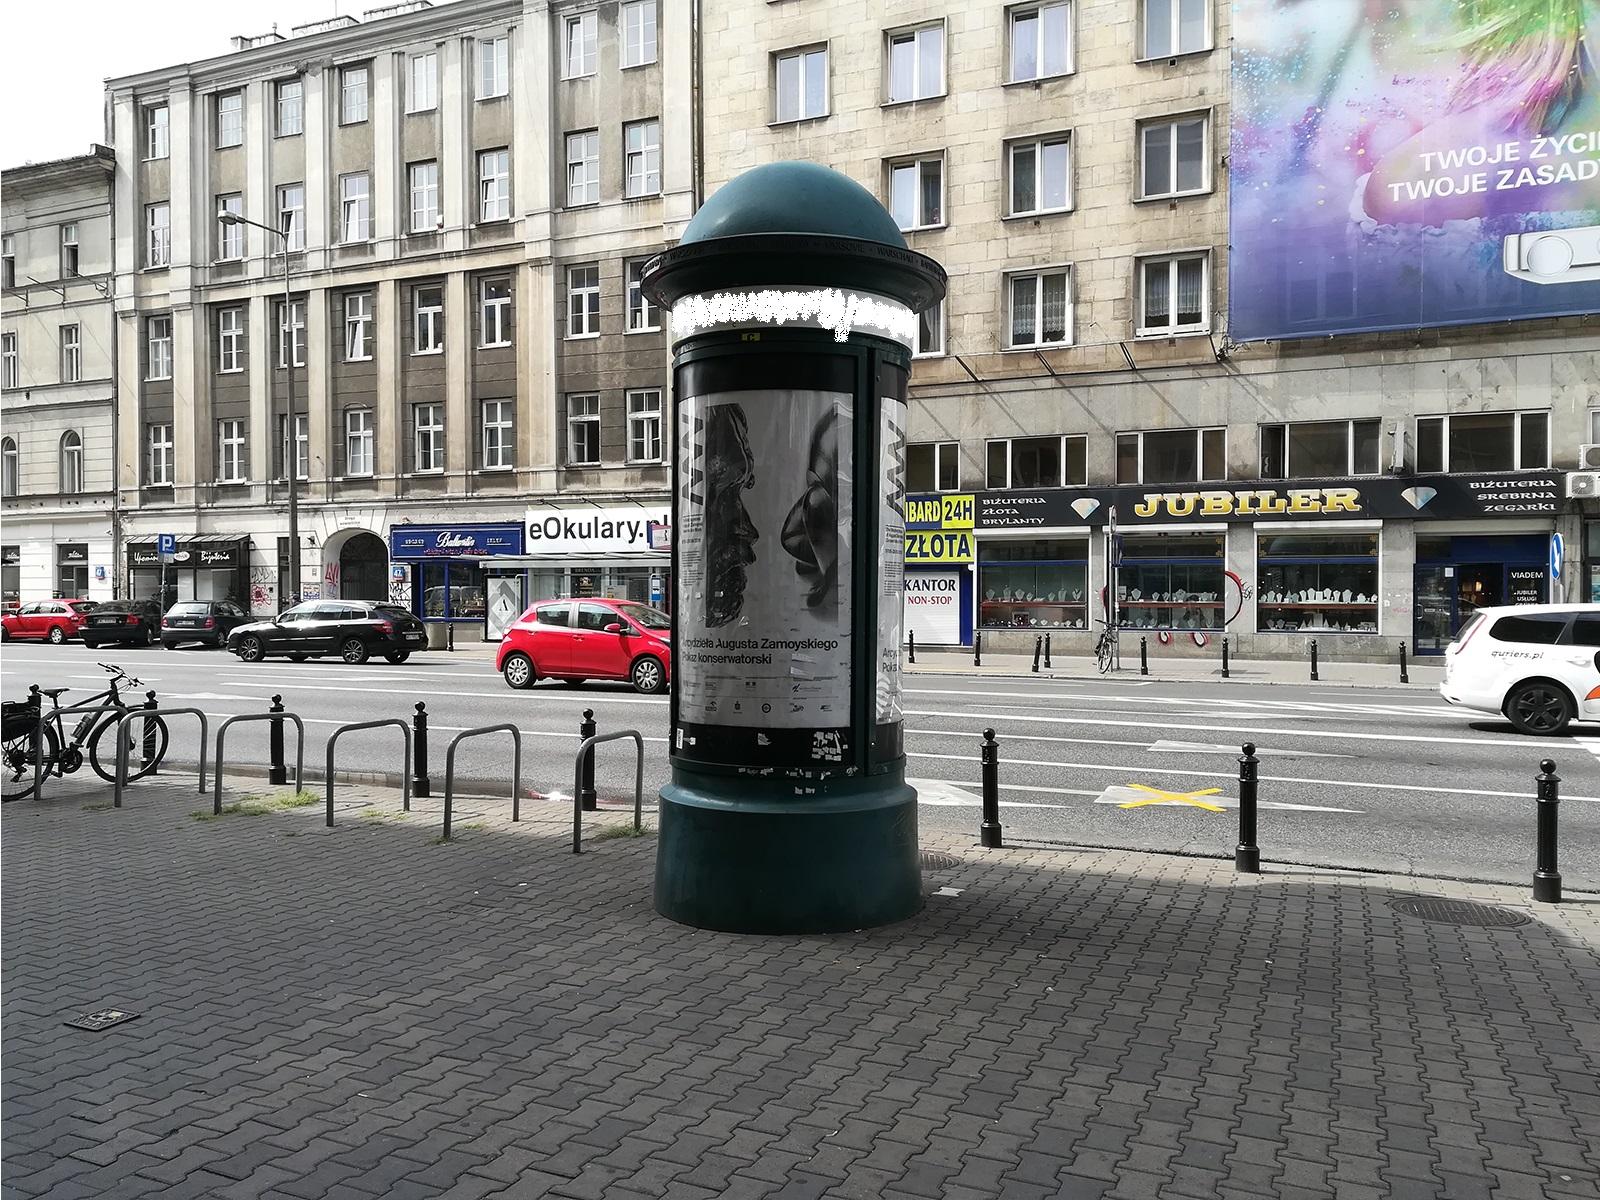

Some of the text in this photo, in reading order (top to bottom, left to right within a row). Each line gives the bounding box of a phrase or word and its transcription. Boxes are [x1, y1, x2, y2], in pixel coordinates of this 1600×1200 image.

[1420, 131, 1600, 172] TWOJE ŻYCI
[1388, 158, 1600, 202] TWOJE ZASAD
[1134, 487, 1363, 518] JUBILER
[944, 500, 973, 521] 24H
[162, 536, 172, 551] P
[905, 533, 971, 558] ZŁOTA
[134, 552, 159, 565] Upomin
[904, 579, 956, 591] KANTOR
[907, 596, 953, 605] NON-STOP
[715, 638, 758, 650] Augusta
[760, 638, 839, 651] Zamoyskiego
[697, 652, 772, 664] konserwatorski
[1491, 650, 1545, 660] quriers.pl
